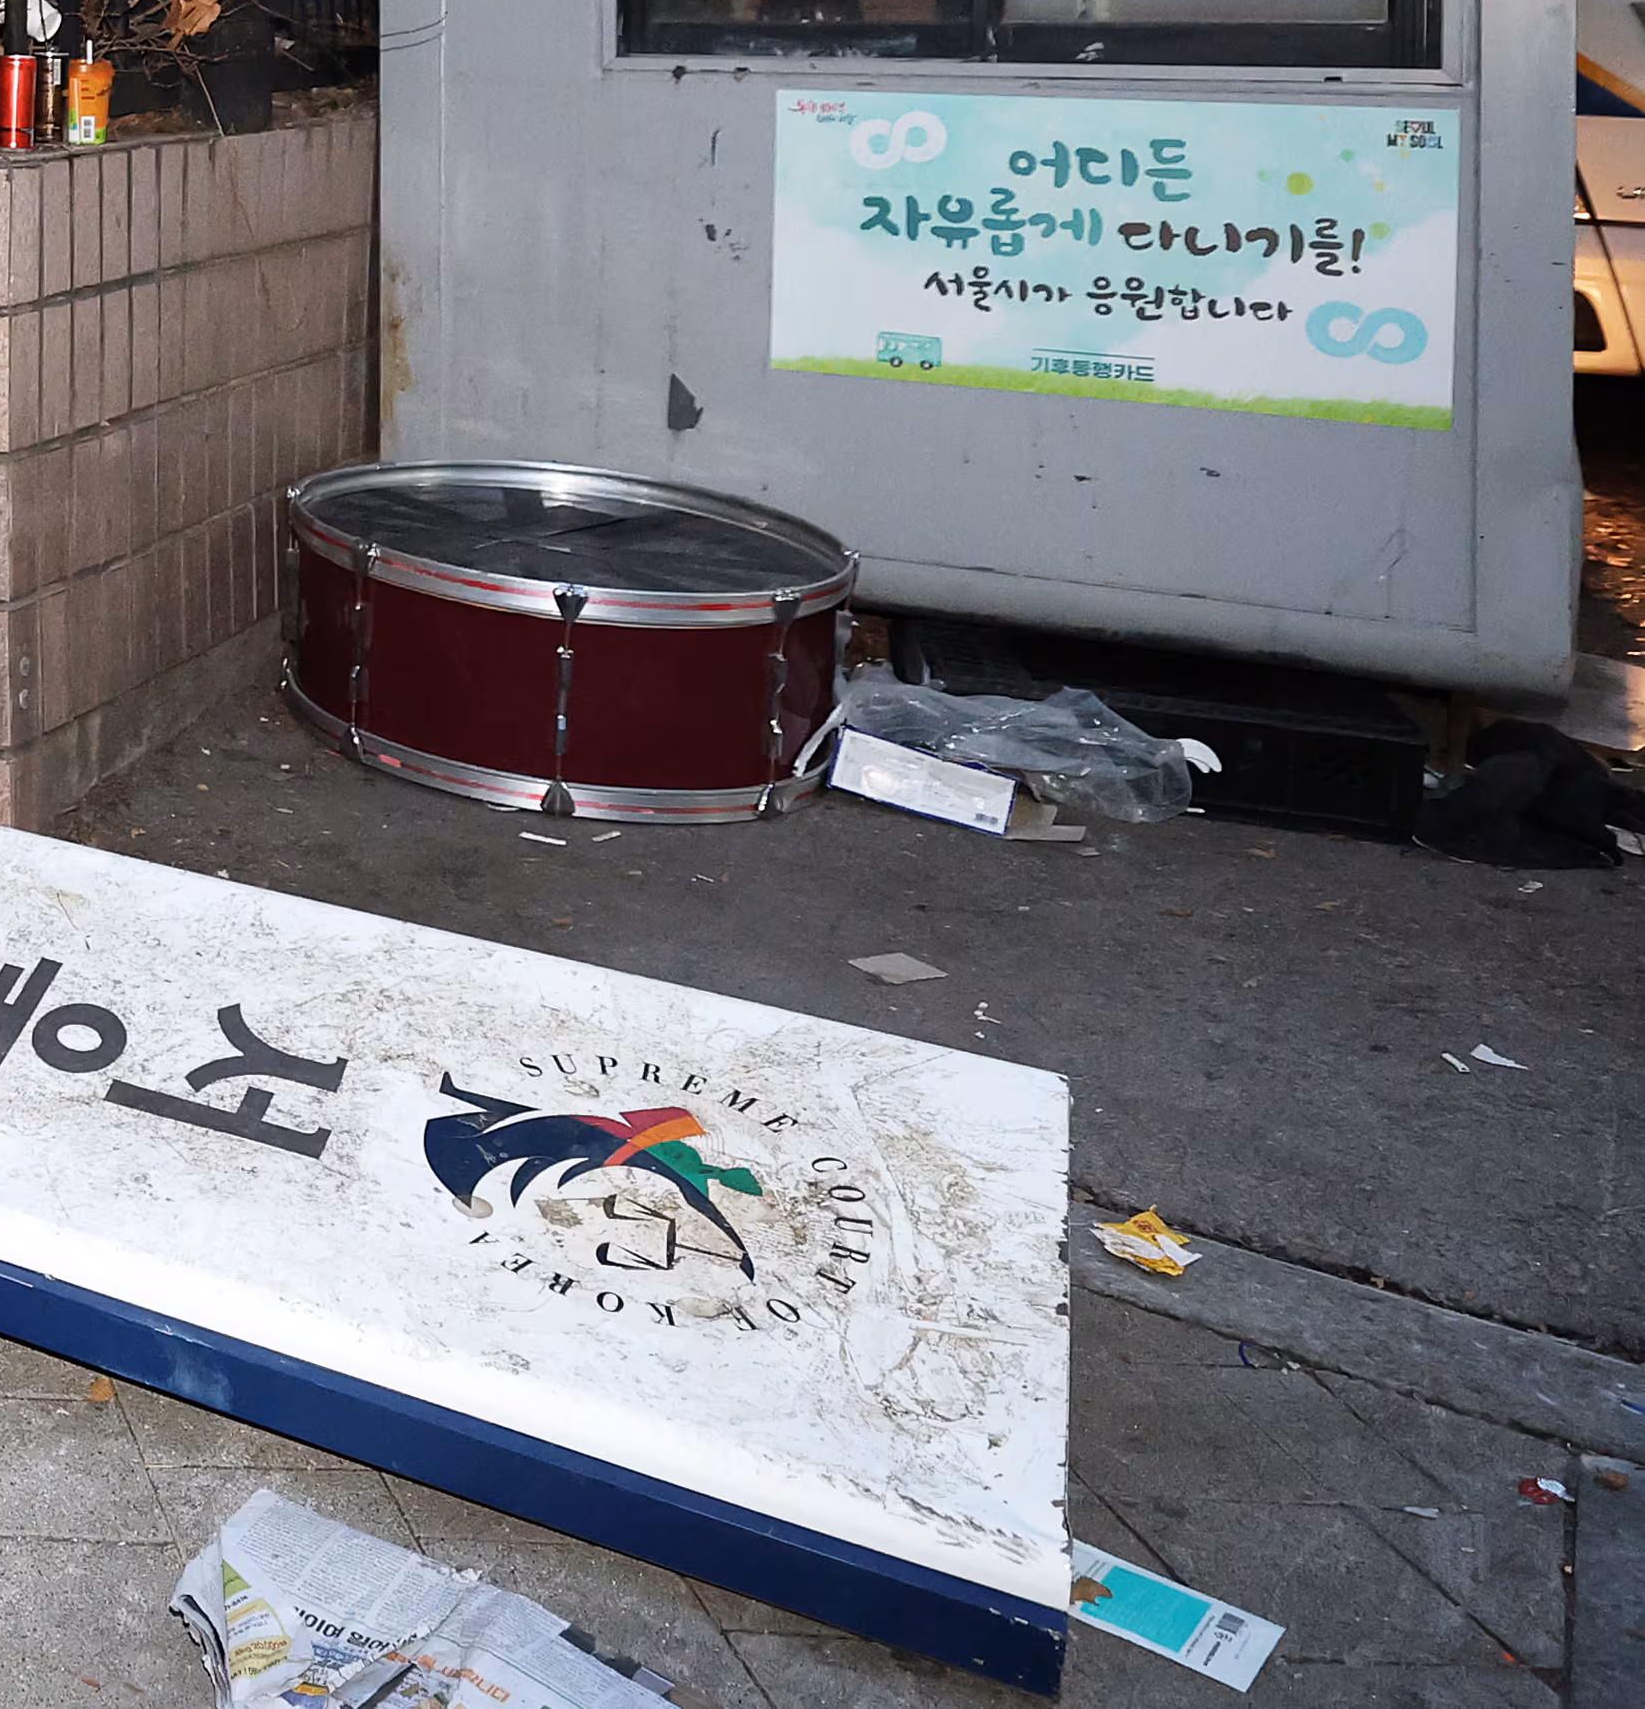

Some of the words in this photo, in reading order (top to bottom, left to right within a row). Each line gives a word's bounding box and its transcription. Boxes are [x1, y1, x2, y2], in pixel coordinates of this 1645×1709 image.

[1009, 138, 1193, 202] 어디든
[860, 187, 1104, 258] 자유롭게
[1117, 217, 1366, 277] 다니기를!
[924, 265, 1072, 313] 서울시가
[1086, 275, 1293, 322] 응원합니다
[1031, 356, 1156, 383] 기후동행카드
[519, 1053, 801, 1137] SUPREME
[810, 1155, 876, 1295] COURT
[468, 1229, 679, 1327] KOREA
[728, 1297, 801, 1332] OF
